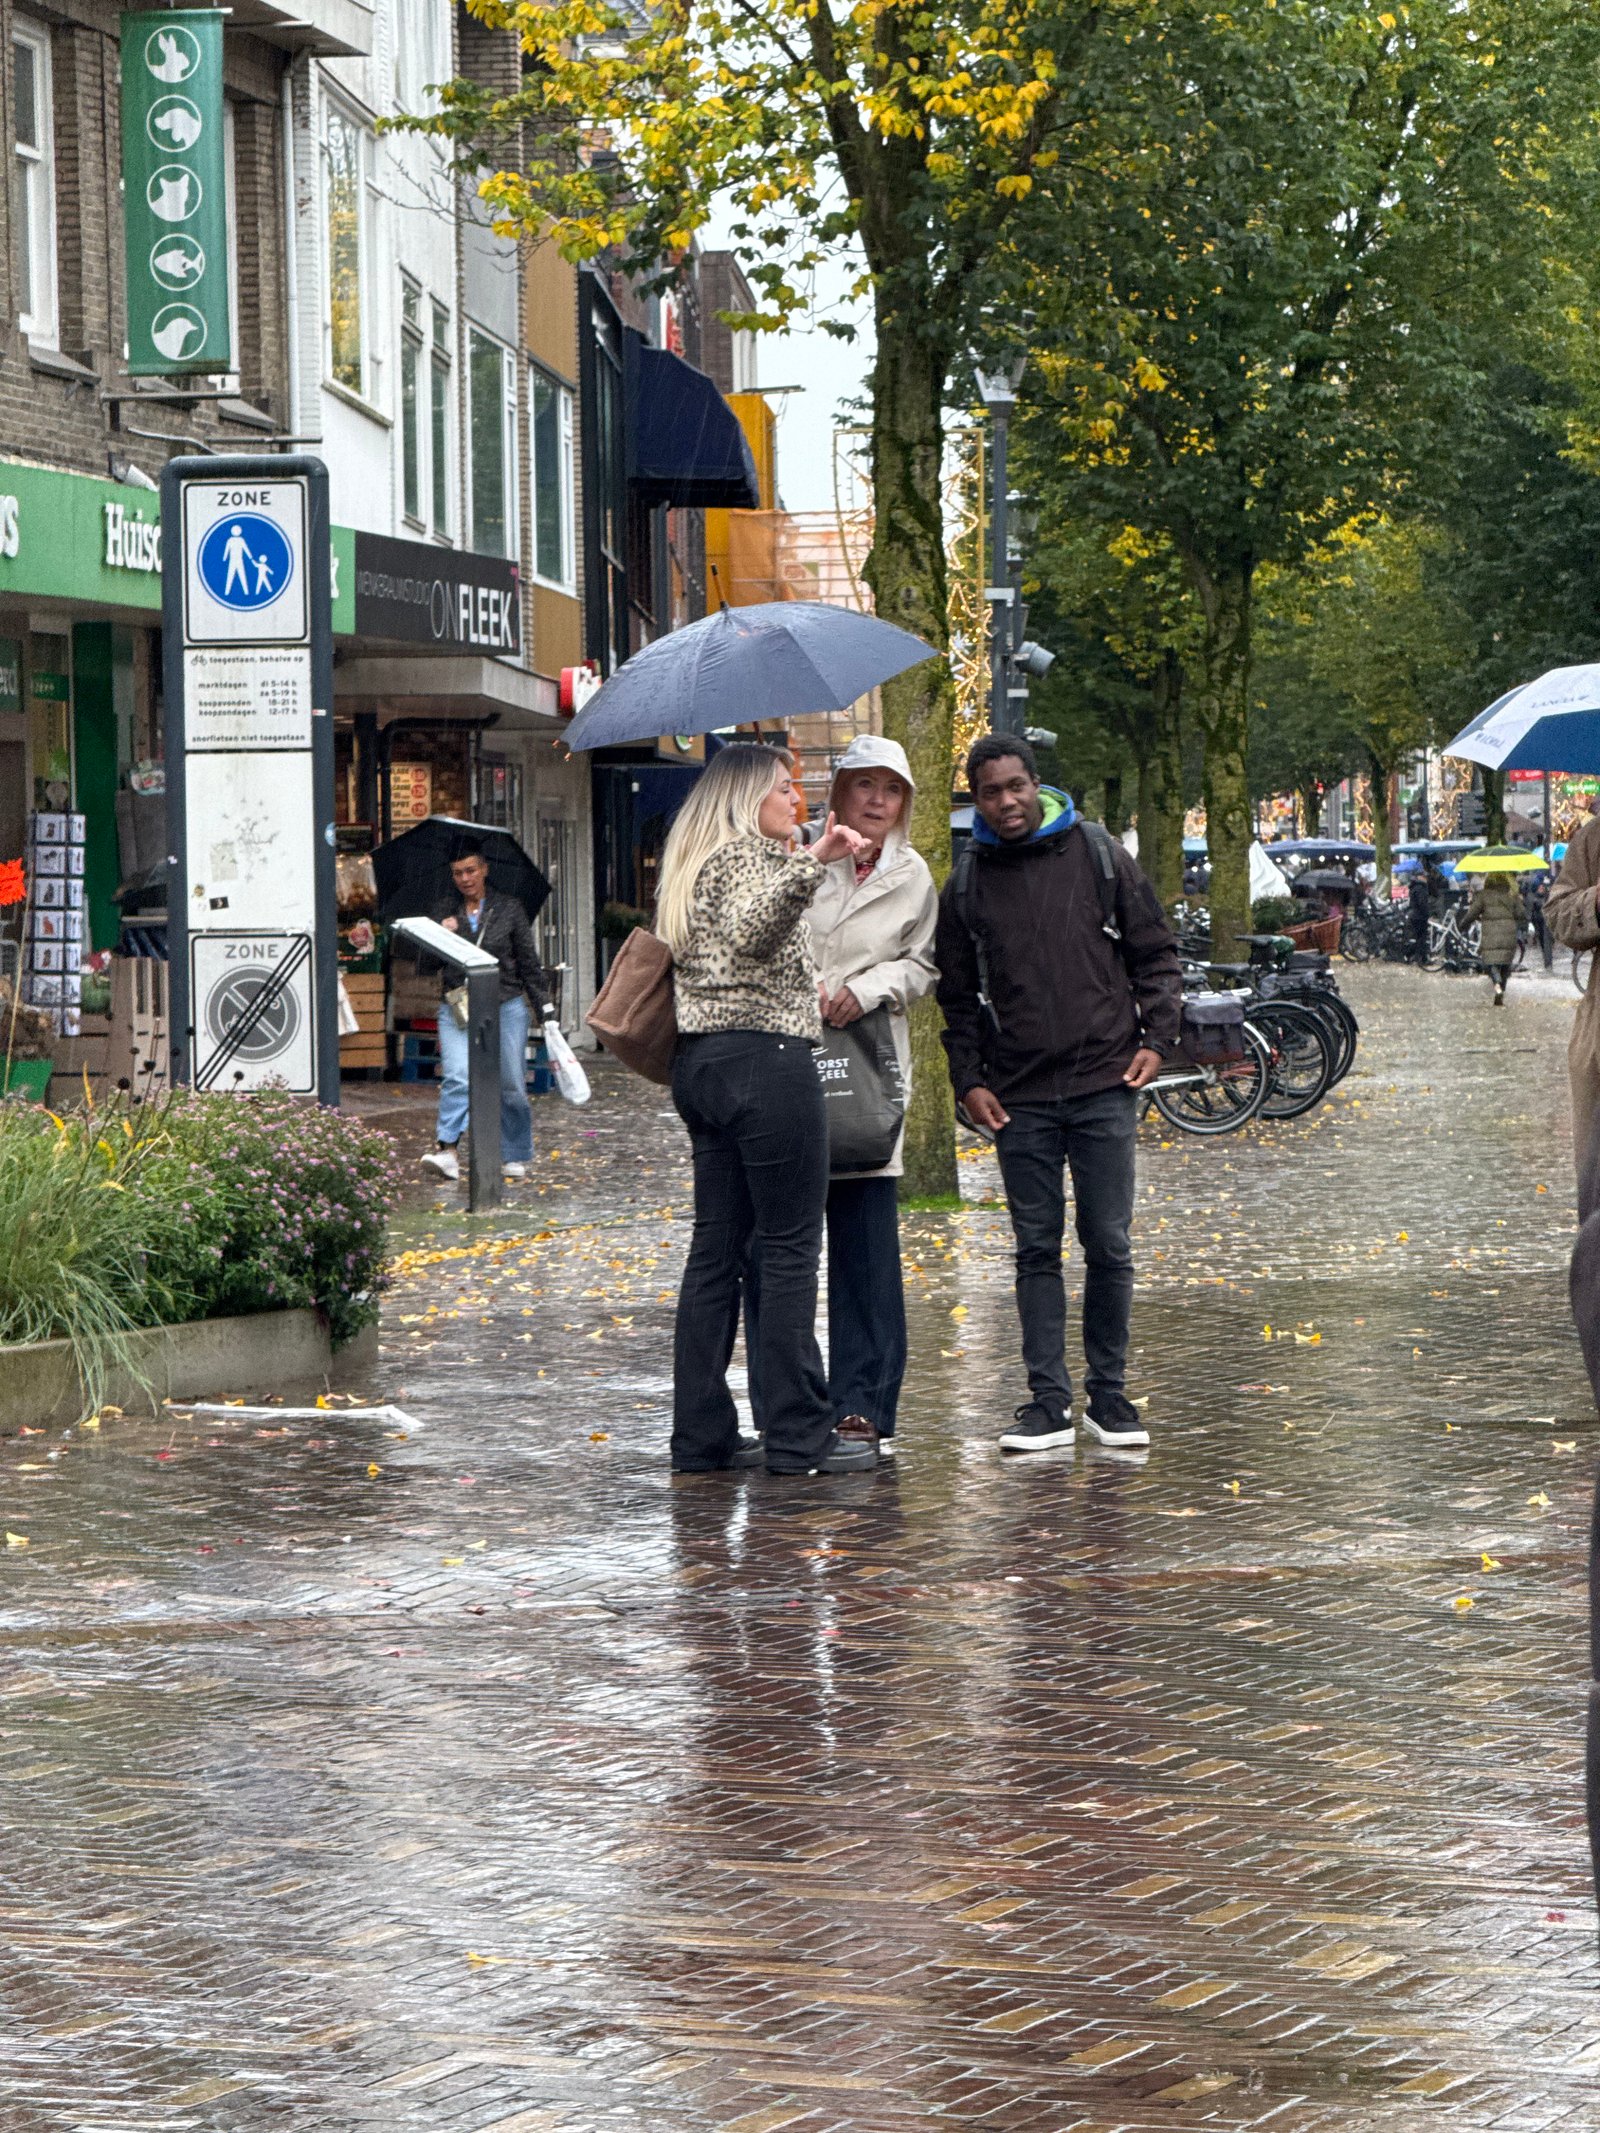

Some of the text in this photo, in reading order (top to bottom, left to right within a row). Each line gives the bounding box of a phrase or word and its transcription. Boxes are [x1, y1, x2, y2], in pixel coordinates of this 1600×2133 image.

[217, 491, 271, 506] ZONE
[259, 655, 291, 663] behalve
[198, 681, 248, 689] marktdagen
[198, 699, 252, 708] koopavonden
[198, 708, 256, 717] koopzondagen
[192, 734, 239, 742] snorfietsen
[260, 734, 305, 742] toegestaan
[224, 944, 279, 959] ZONE
